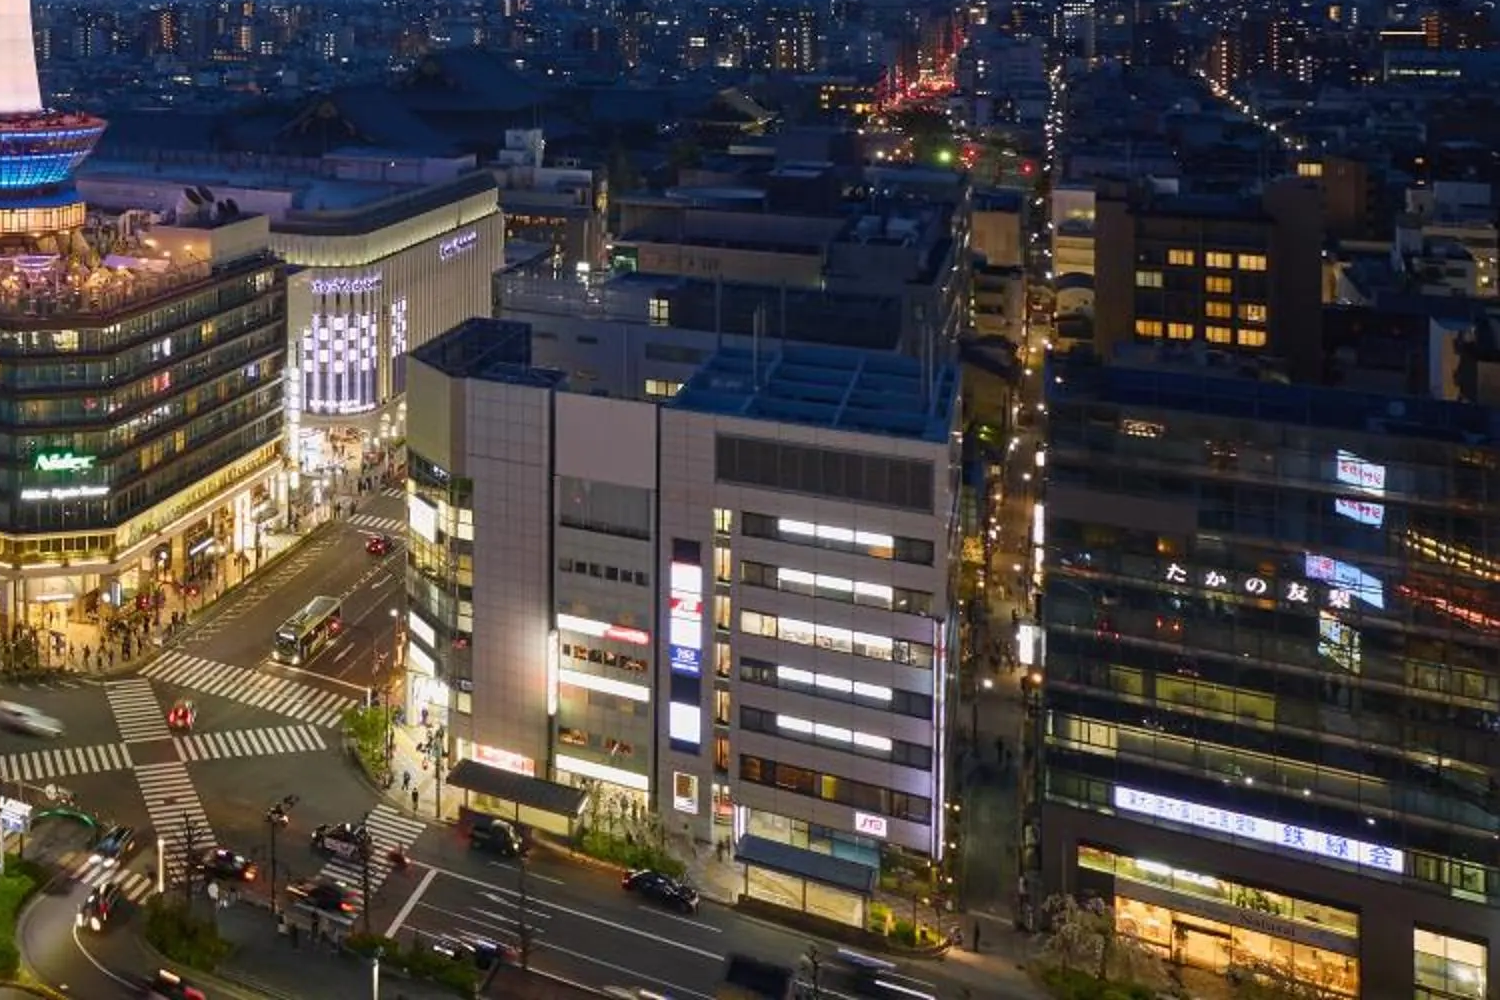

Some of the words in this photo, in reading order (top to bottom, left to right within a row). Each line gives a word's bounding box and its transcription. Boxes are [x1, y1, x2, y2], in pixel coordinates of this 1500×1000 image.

[35, 452, 97, 473] Nidec
[1166, 563, 1351, 608] たかの友梨
[1283, 825, 1392, 867] 鉄緑会
